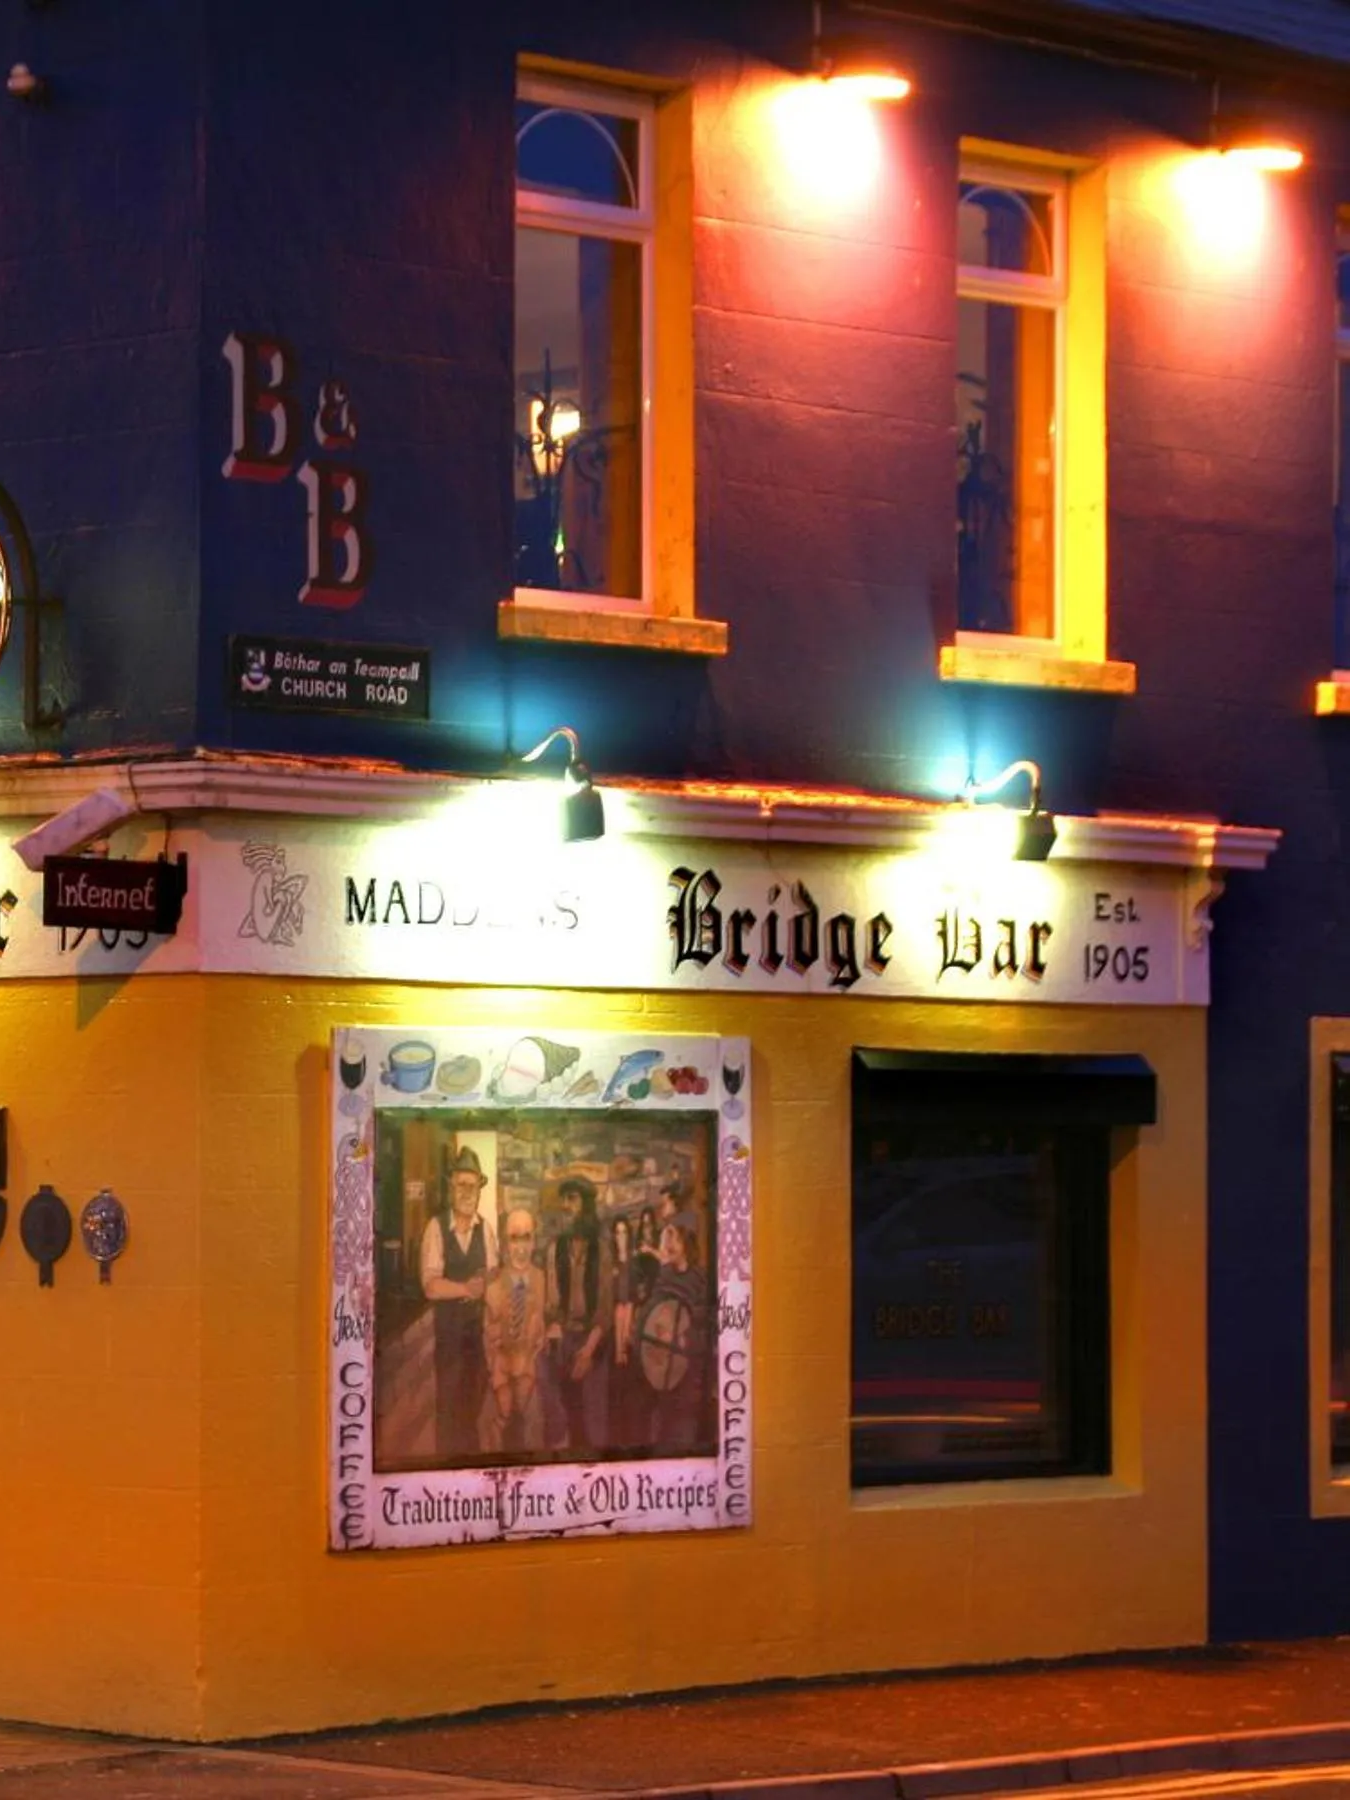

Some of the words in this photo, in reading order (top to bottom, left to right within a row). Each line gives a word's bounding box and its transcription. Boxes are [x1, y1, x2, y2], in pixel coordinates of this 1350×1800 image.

[281, 676, 347, 700] CHURCH
[365, 683, 408, 705] ROAD
[328, 661, 348, 676] an
[56, 871, 157, 911] Internet
[343, 874, 581, 932] MADS
[667, 866, 894, 993] Bridge
[934, 885, 1053, 984] Bar
[1083, 943, 1150, 983] 1905
[339, 1361, 367, 1541] COFFEE
[723, 1350, 748, 1519] COFFEE
[381, 1480, 500, 1526] Traditional
[503, 1480, 555, 1528] Fare
[563, 1483, 585, 1514] &
[588, 1474, 629, 1515] Old
[636, 1471, 716, 1516] Recipes
